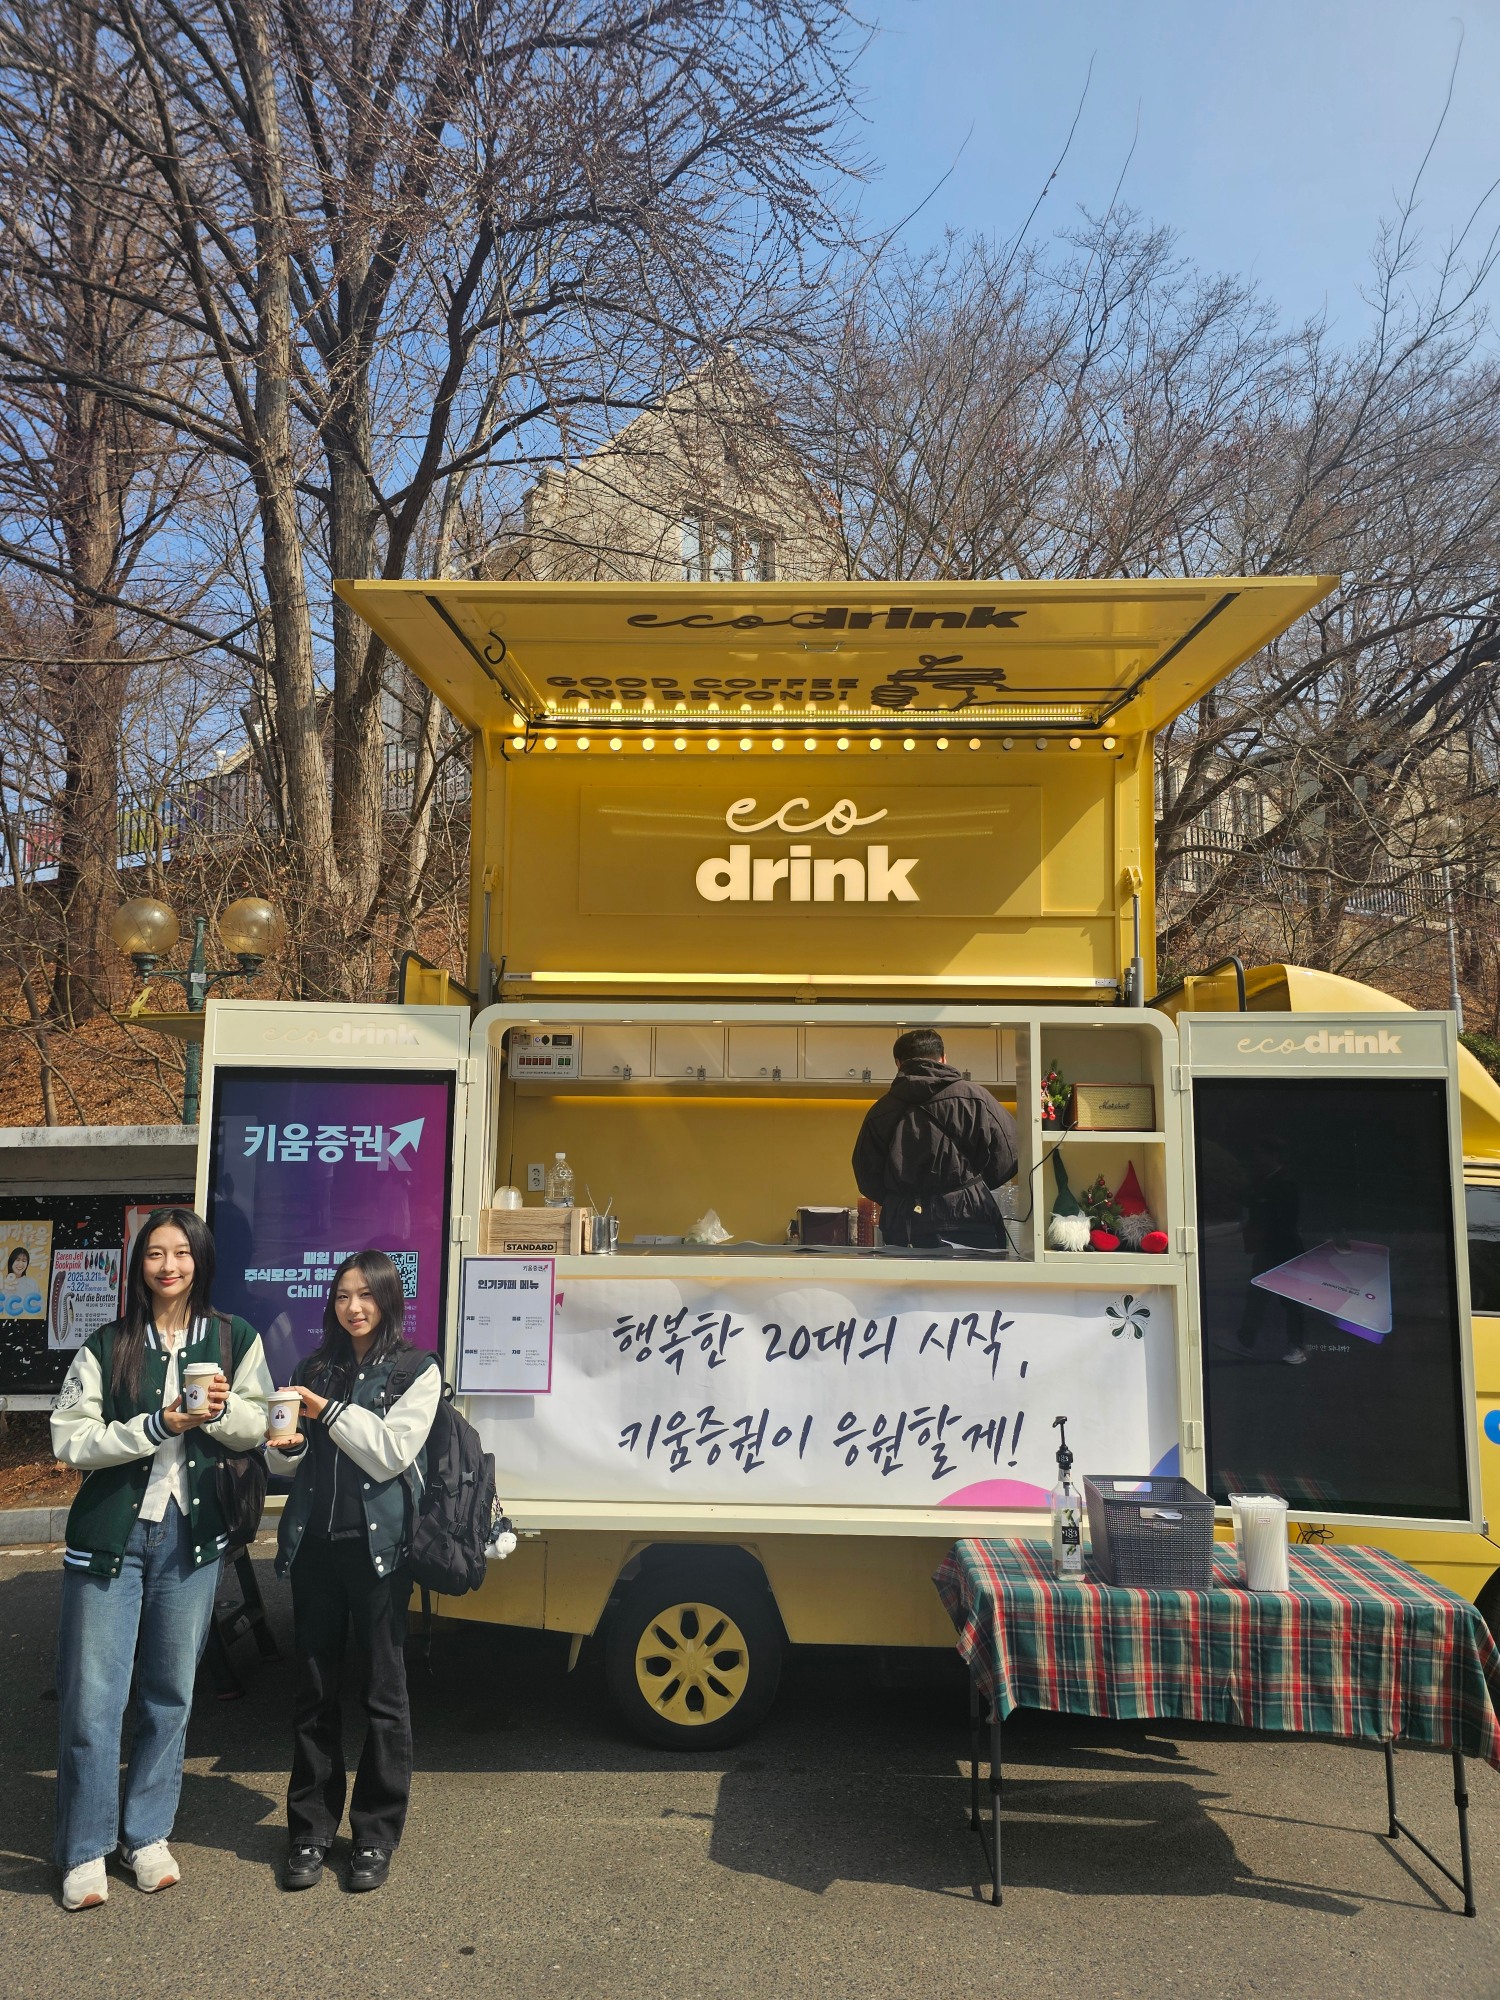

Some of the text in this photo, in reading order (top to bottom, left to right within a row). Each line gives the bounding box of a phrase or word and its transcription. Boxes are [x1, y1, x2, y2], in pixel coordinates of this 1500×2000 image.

[547, 676, 859, 689] GOOD COFFEE
[562, 689, 848, 701] AND BEYOND!
[725, 797, 888, 835] eco
[695, 844, 920, 901] drink
[243, 1123, 383, 1163] 키움증권
[506, 1243, 554, 1251] STANDARD
[56, 1252, 73, 1260] Caren
[303, 1251, 330, 1265] 매일
[55, 1260, 82, 1271] Bookpink
[67, 1271, 98, 1282] 2025.3.21
[244, 1268, 311, 1282] 주식모으기
[478, 1279, 539, 1290] 인기카페 메뉴
[75, 1292, 116, 1302] Auf die Bretter
[287, 1284, 323, 1299] Chill
[612, 1306, 1029, 1381] 행복한 20대의 시작,
[617, 1405, 813, 1475] 키움증권이
